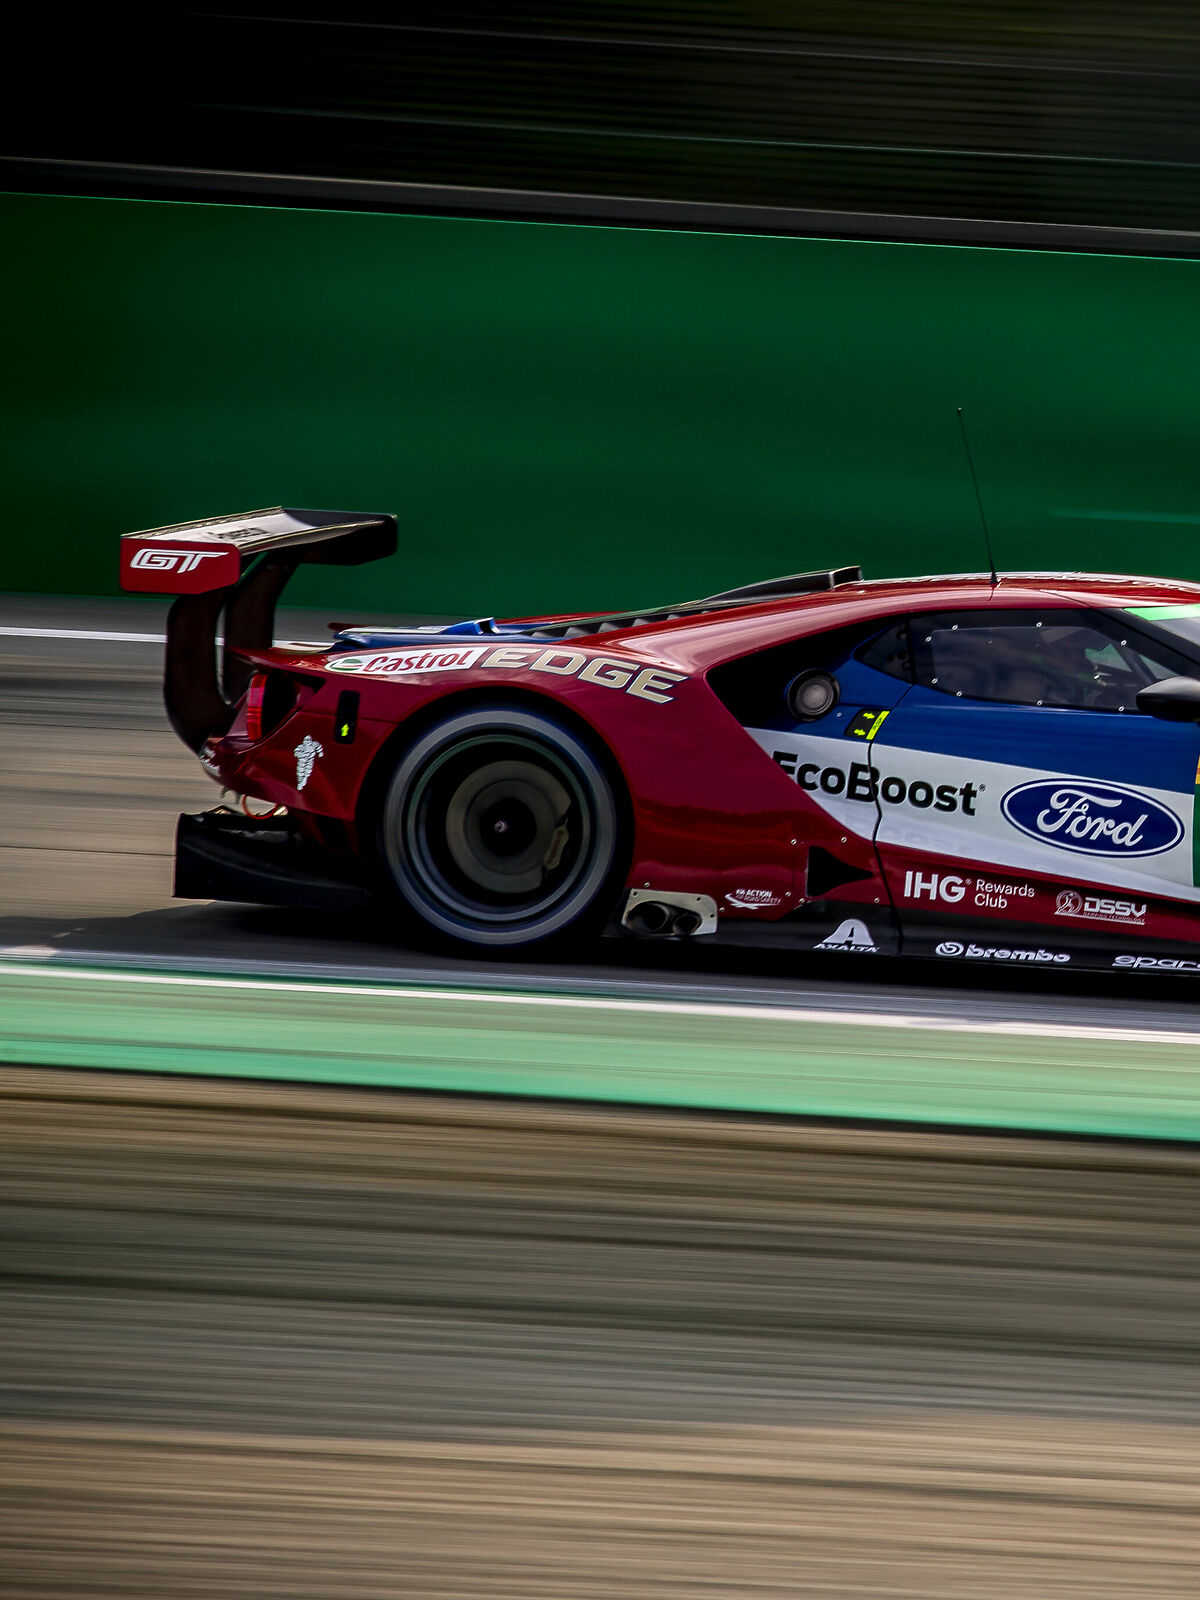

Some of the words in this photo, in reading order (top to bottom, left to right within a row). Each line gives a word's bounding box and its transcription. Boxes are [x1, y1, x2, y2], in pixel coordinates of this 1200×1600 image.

[130, 548, 229, 574] GT
[364, 650, 474, 673] Castrol
[480, 648, 689, 704] EDGE
[1036, 788, 1149, 848] Ford
[903, 870, 966, 903] IHG
[975, 879, 1035, 897] Rewards
[974, 893, 1008, 909] Club
[1083, 896, 1147, 917] DSSV
[813, 943, 880, 953] AXALTA
[965, 944, 1071, 963] brembo
